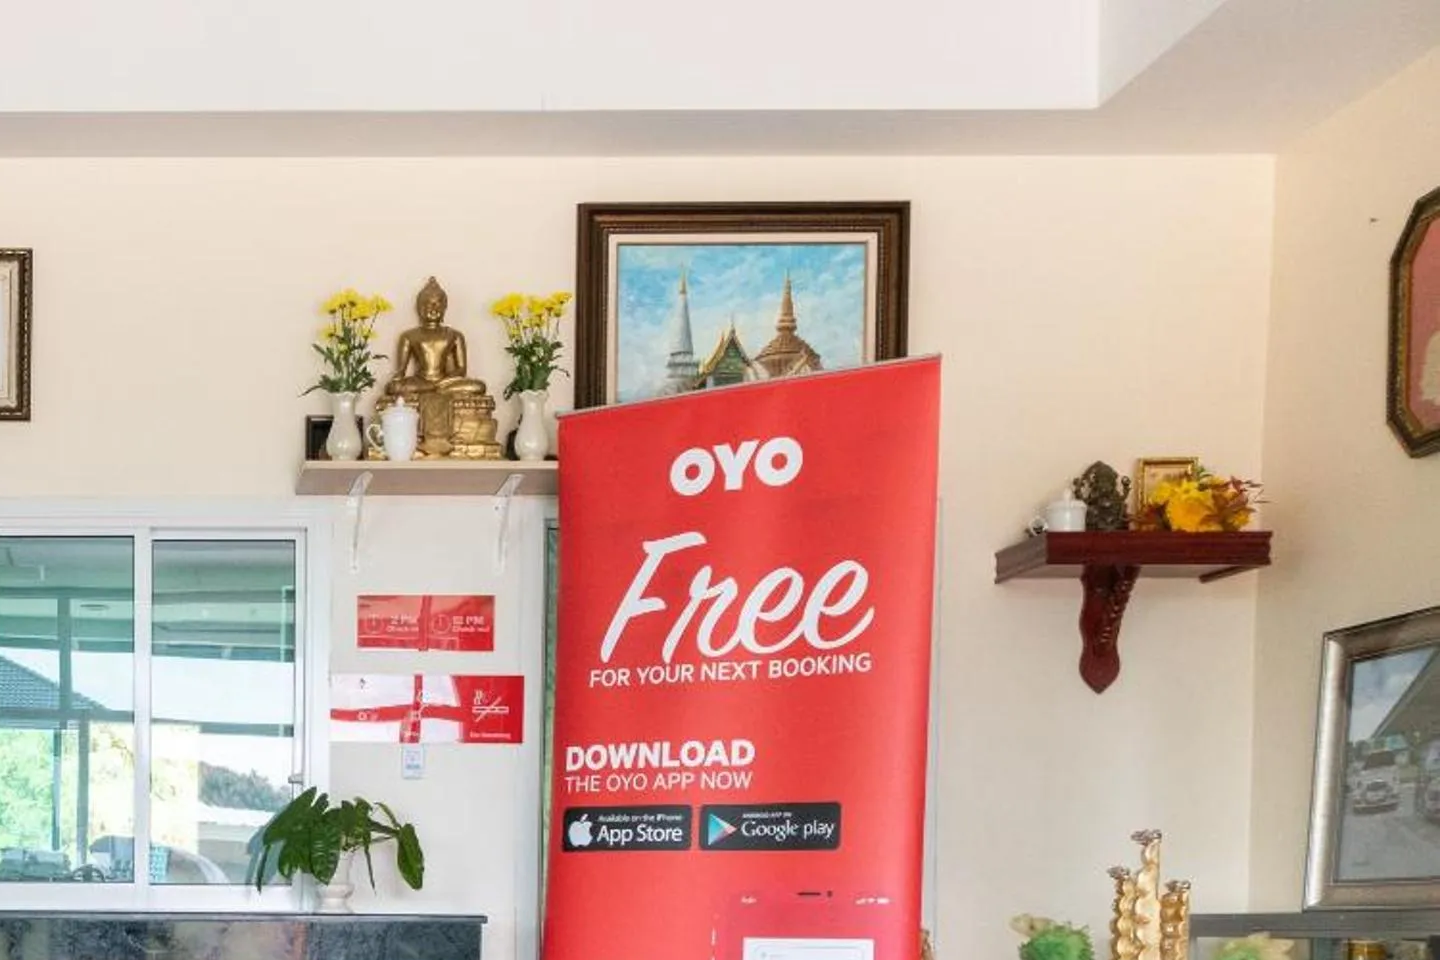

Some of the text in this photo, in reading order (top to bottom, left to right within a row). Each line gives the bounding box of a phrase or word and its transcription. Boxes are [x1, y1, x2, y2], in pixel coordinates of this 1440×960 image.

[670, 436, 804, 497] OYO
[600, 531, 876, 664] Free
[589, 652, 873, 688] FOR YOUR NEXT BOOKING
[565, 739, 756, 772] DOWNLOAD
[565, 771, 752, 794] THE OYO APP NOW
[597, 824, 682, 846] App Store
[741, 820, 835, 842] Google play
